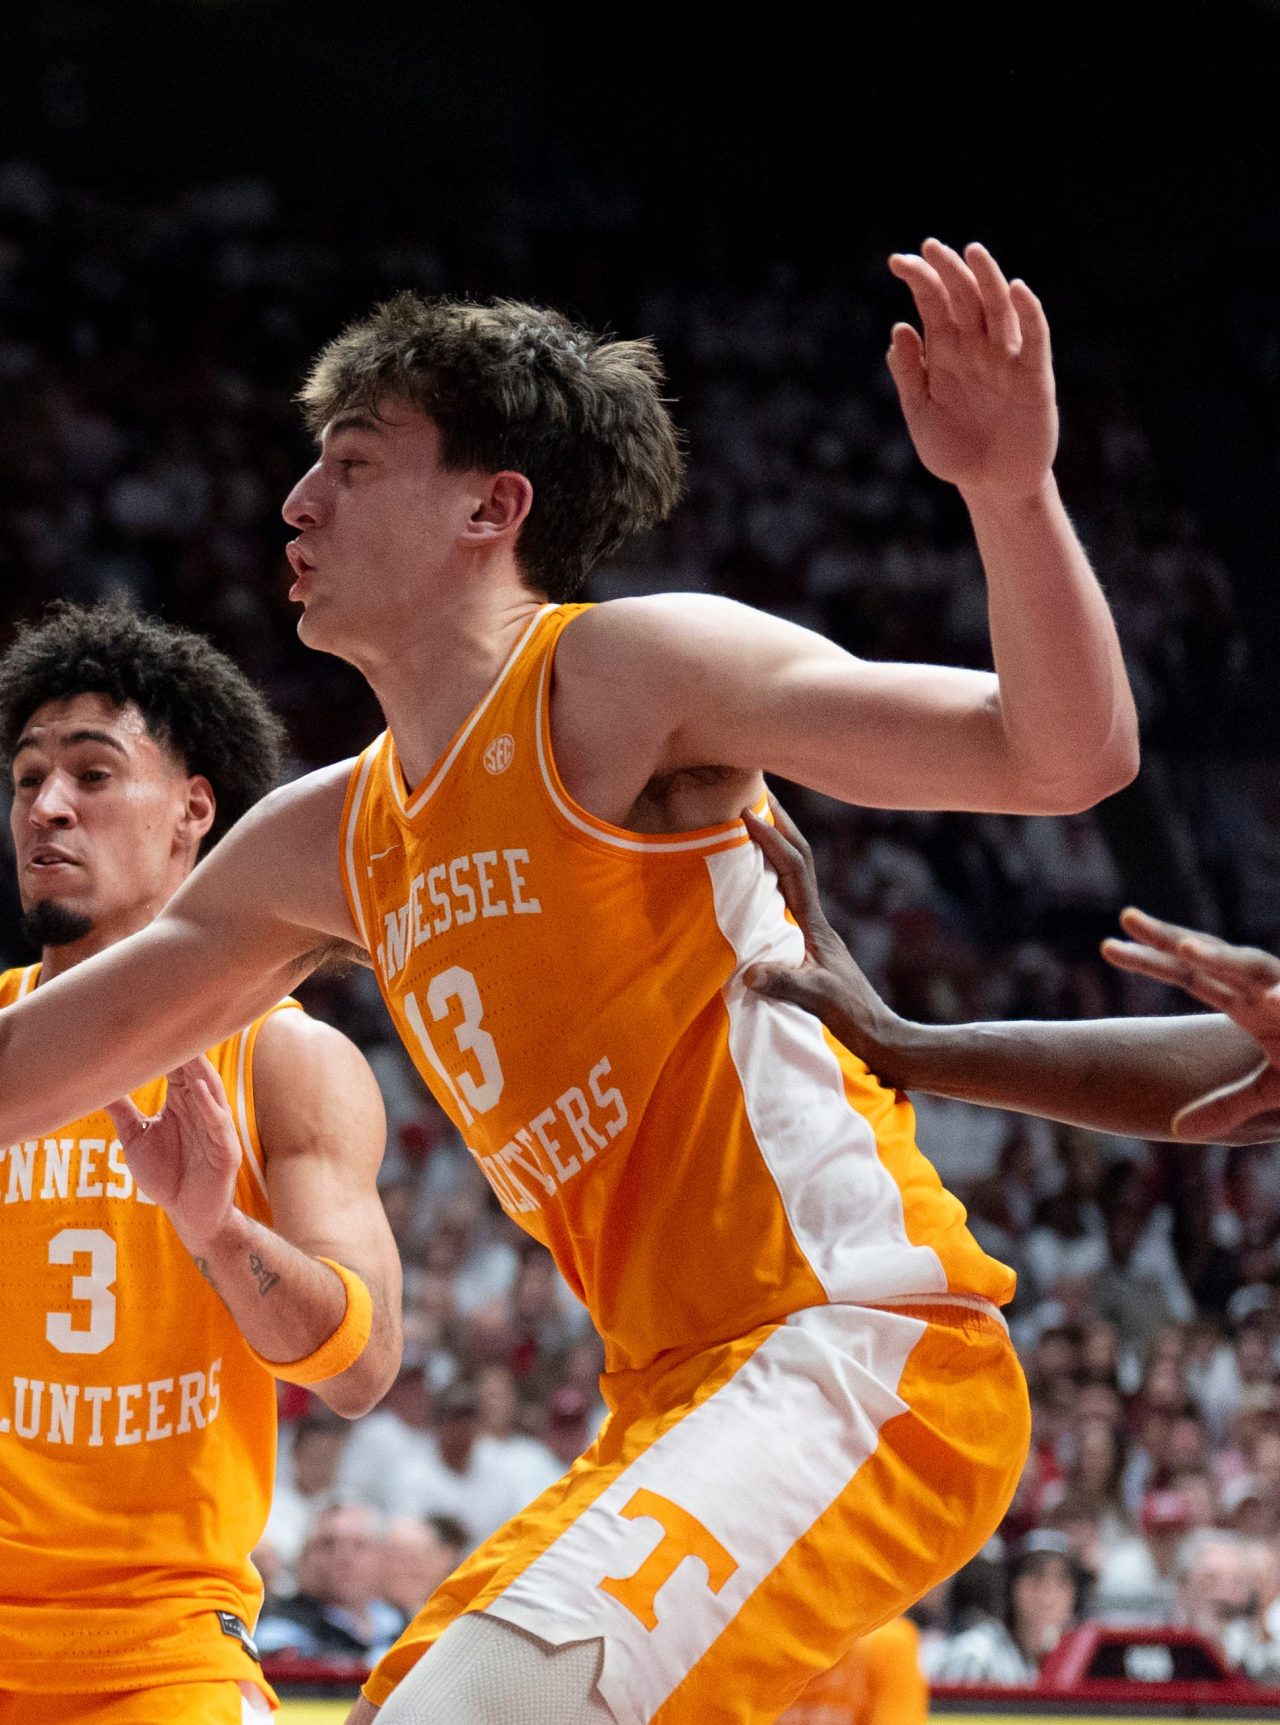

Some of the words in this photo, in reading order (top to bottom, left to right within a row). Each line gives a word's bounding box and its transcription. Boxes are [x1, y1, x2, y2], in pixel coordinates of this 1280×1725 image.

[484, 734, 514, 774] SEC
[377, 849, 543, 981] NESSEE
[404, 965, 505, 1127] 13
[45, 1228, 117, 1355] 3
[596, 1487, 740, 1632] T
